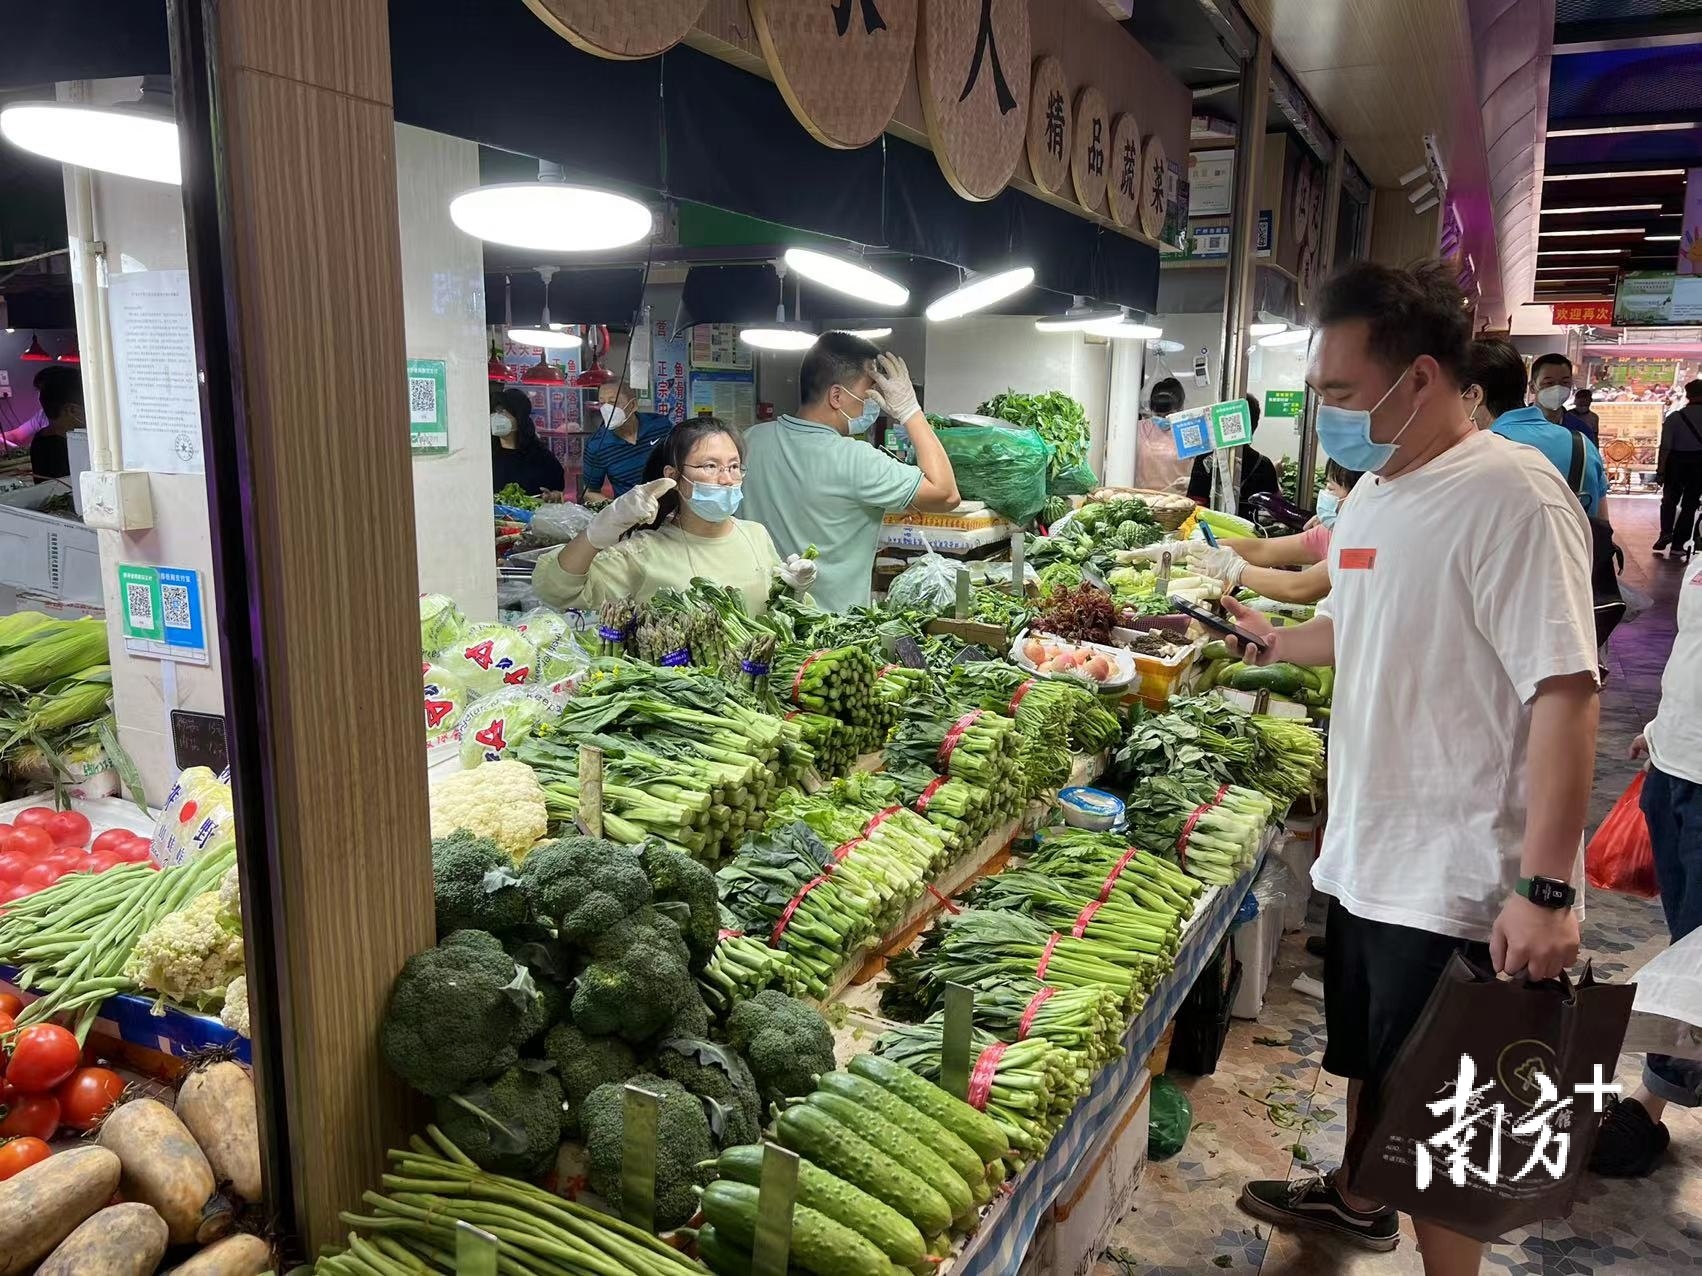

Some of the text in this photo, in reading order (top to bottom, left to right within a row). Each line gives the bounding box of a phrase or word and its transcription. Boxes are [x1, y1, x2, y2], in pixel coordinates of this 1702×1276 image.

[1045, 90, 1164, 215] 精品蔬菜
[1556, 306, 1613, 321] 欢迎再次
